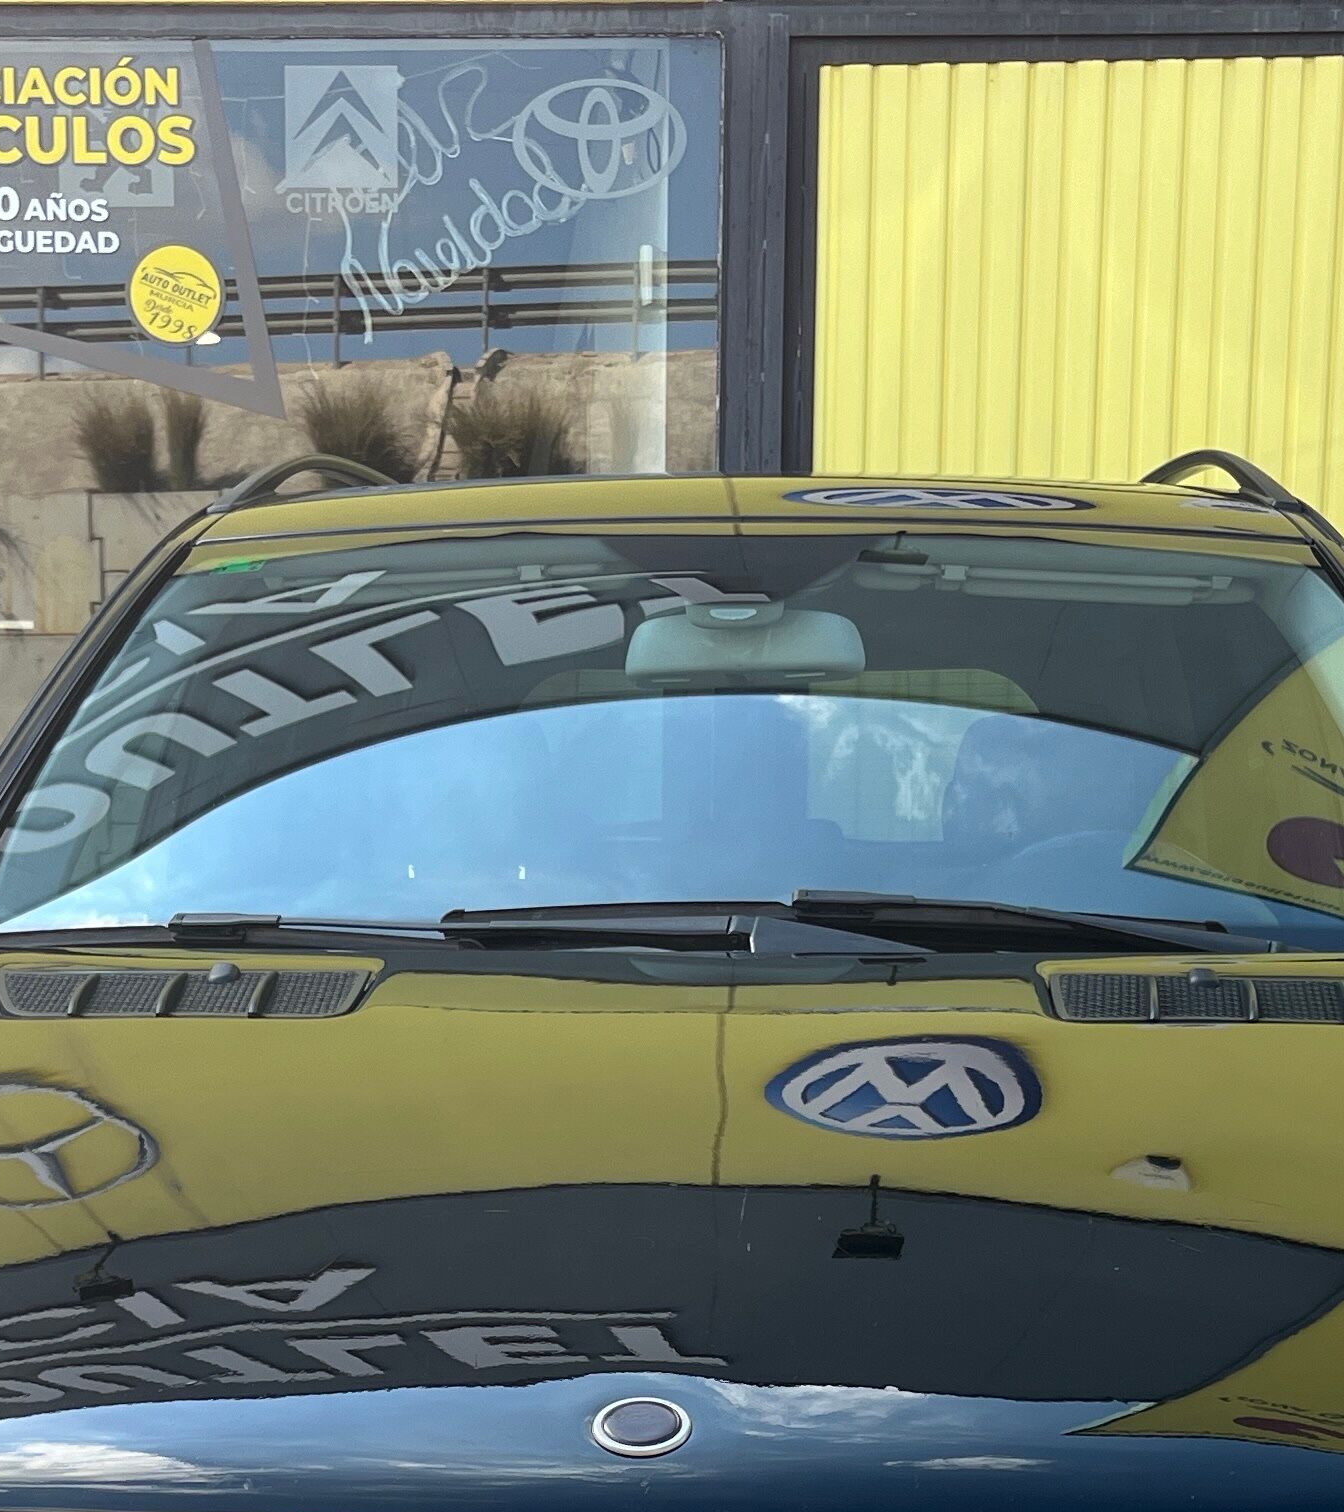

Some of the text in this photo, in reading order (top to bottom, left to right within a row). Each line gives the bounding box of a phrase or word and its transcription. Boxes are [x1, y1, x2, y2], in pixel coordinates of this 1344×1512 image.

[24, 192, 109, 222] AÑOS
[140, 273, 213, 305] AUTO OUTLET
[148, 312, 198, 340] 1998
